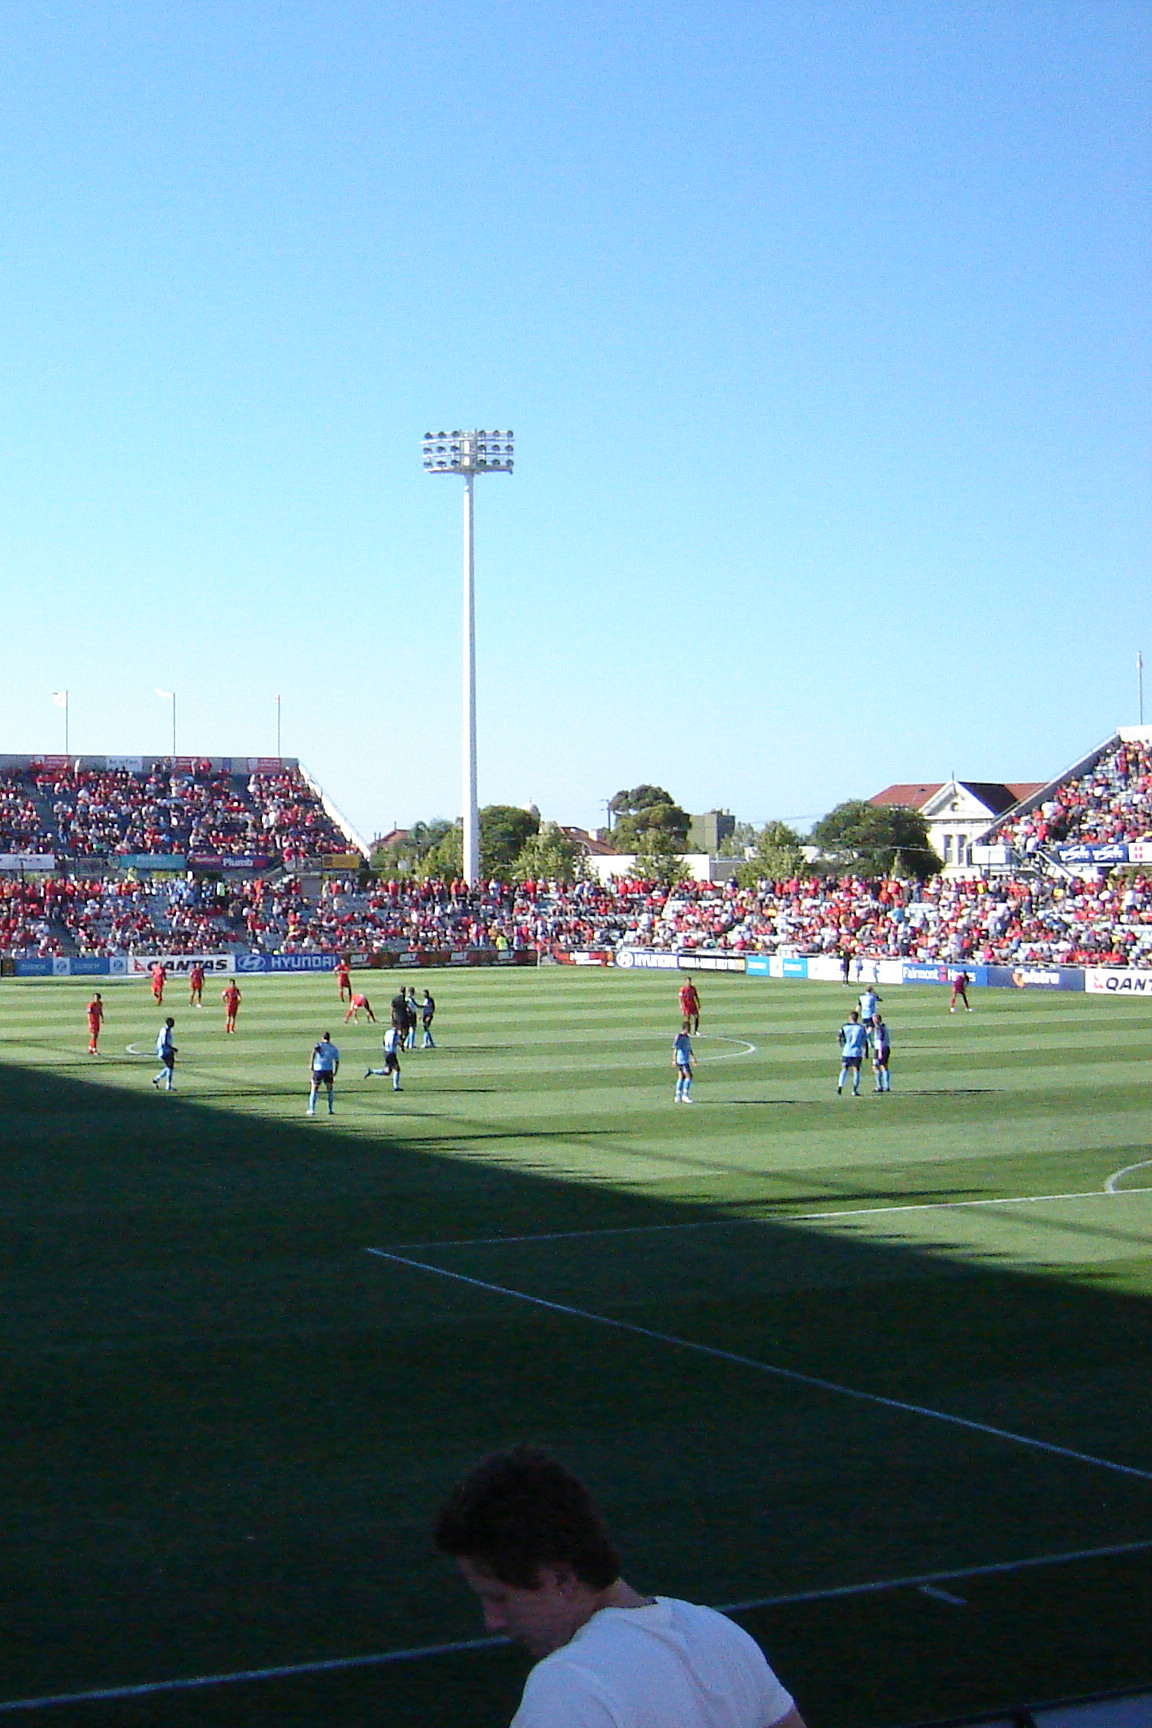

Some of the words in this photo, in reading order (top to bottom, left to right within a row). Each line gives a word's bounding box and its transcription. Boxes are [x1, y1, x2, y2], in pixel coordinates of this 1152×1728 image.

[222, 857, 253, 867] Plumb
[147, 958, 228, 972] QANTAS
[271, 956, 337, 968] HYUNDAI
[634, 953, 678, 968] HYUNDAI
[902, 966, 939, 981] Fairmont
[1012, 968, 1060, 987] Telstra
[1105, 976, 1152, 992] QAN
